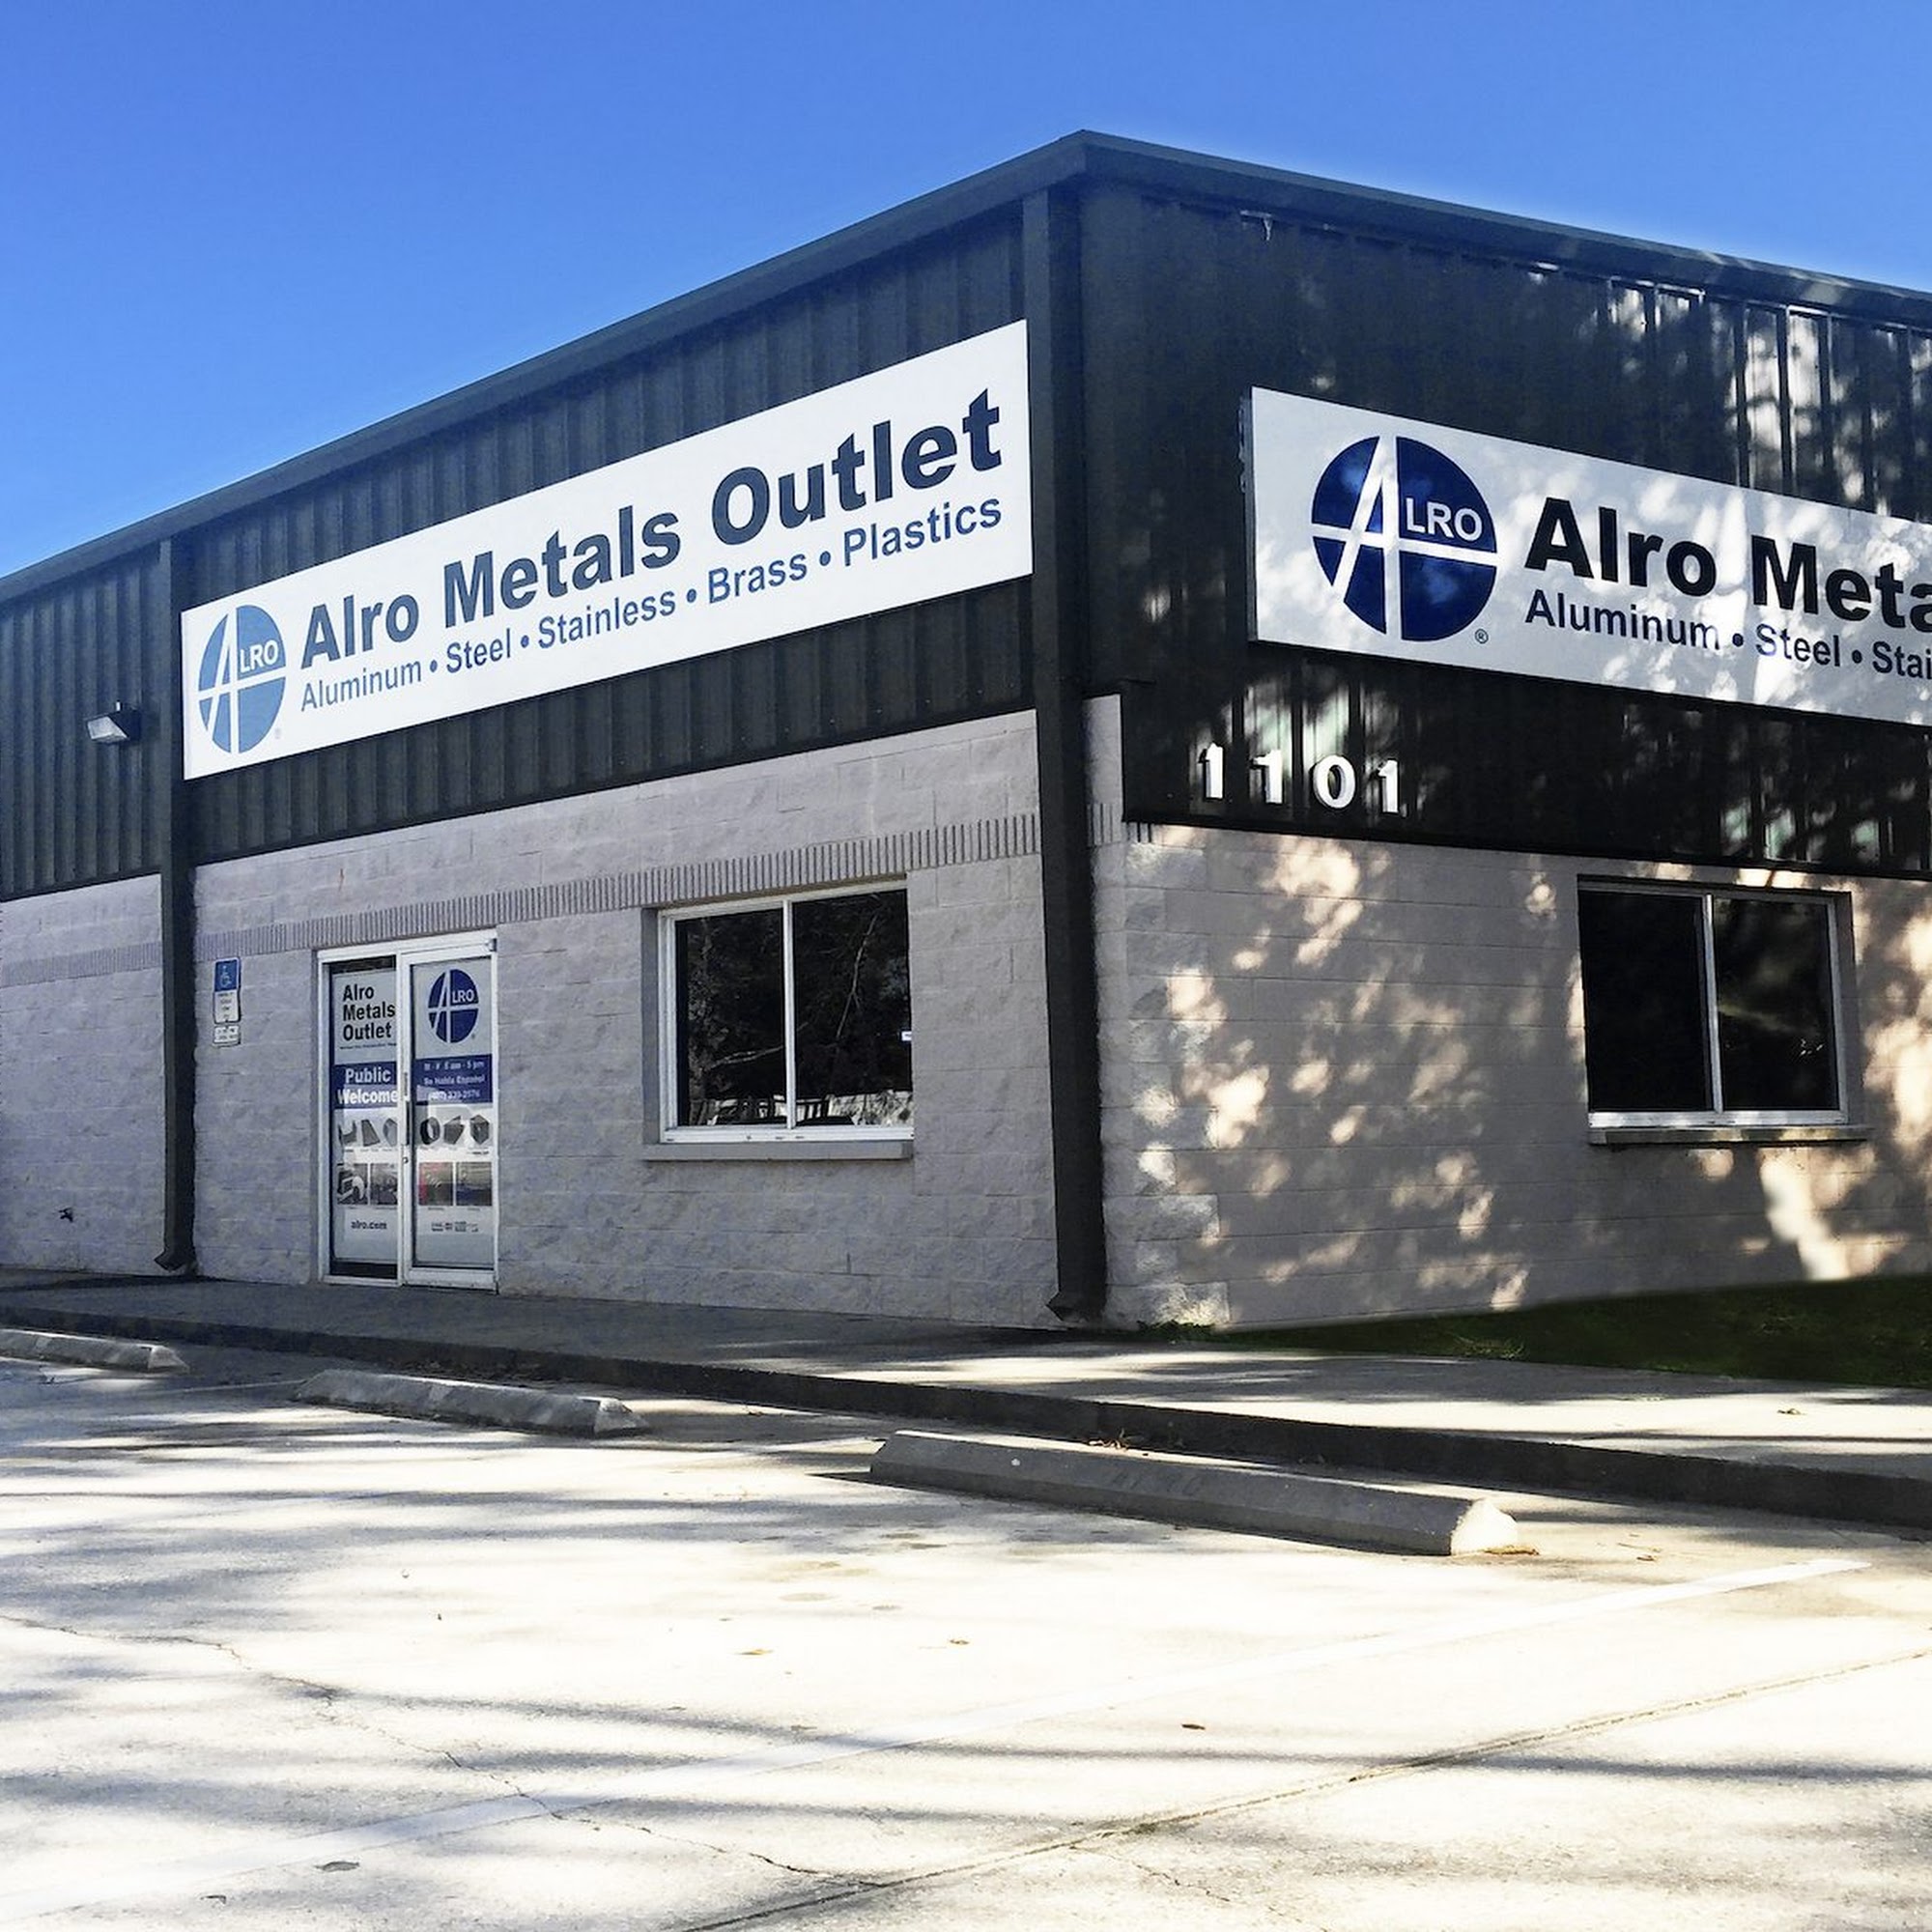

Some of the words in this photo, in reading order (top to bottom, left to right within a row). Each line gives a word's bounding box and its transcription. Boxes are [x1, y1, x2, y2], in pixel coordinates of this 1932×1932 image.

[301, 594, 420, 669] Alro
[443, 505, 681, 628] Metals
[712, 388, 1002, 545] Outlet
[1524, 497, 1717, 597] Alro
[1751, 534, 1932, 633] Meta
[300, 660, 422, 712] Aluminum
[446, 628, 511, 673] Steel
[538, 590, 676, 649] Stainless
[708, 553, 808, 604] Brass
[843, 498, 1002, 567] Plastics
[1525, 589, 1719, 650] Aluminum
[1755, 623, 1840, 667] Steel
[1872, 640, 1932, 680] Stai
[1198, 742, 1399, 814] 1101
[343, 983, 375, 1002] Alro
[343, 1001, 396, 1022] Metals
[343, 1022, 392, 1041] Outlet
[337, 1088, 399, 1104] Welcome
[345, 1066, 392, 1084] Public
